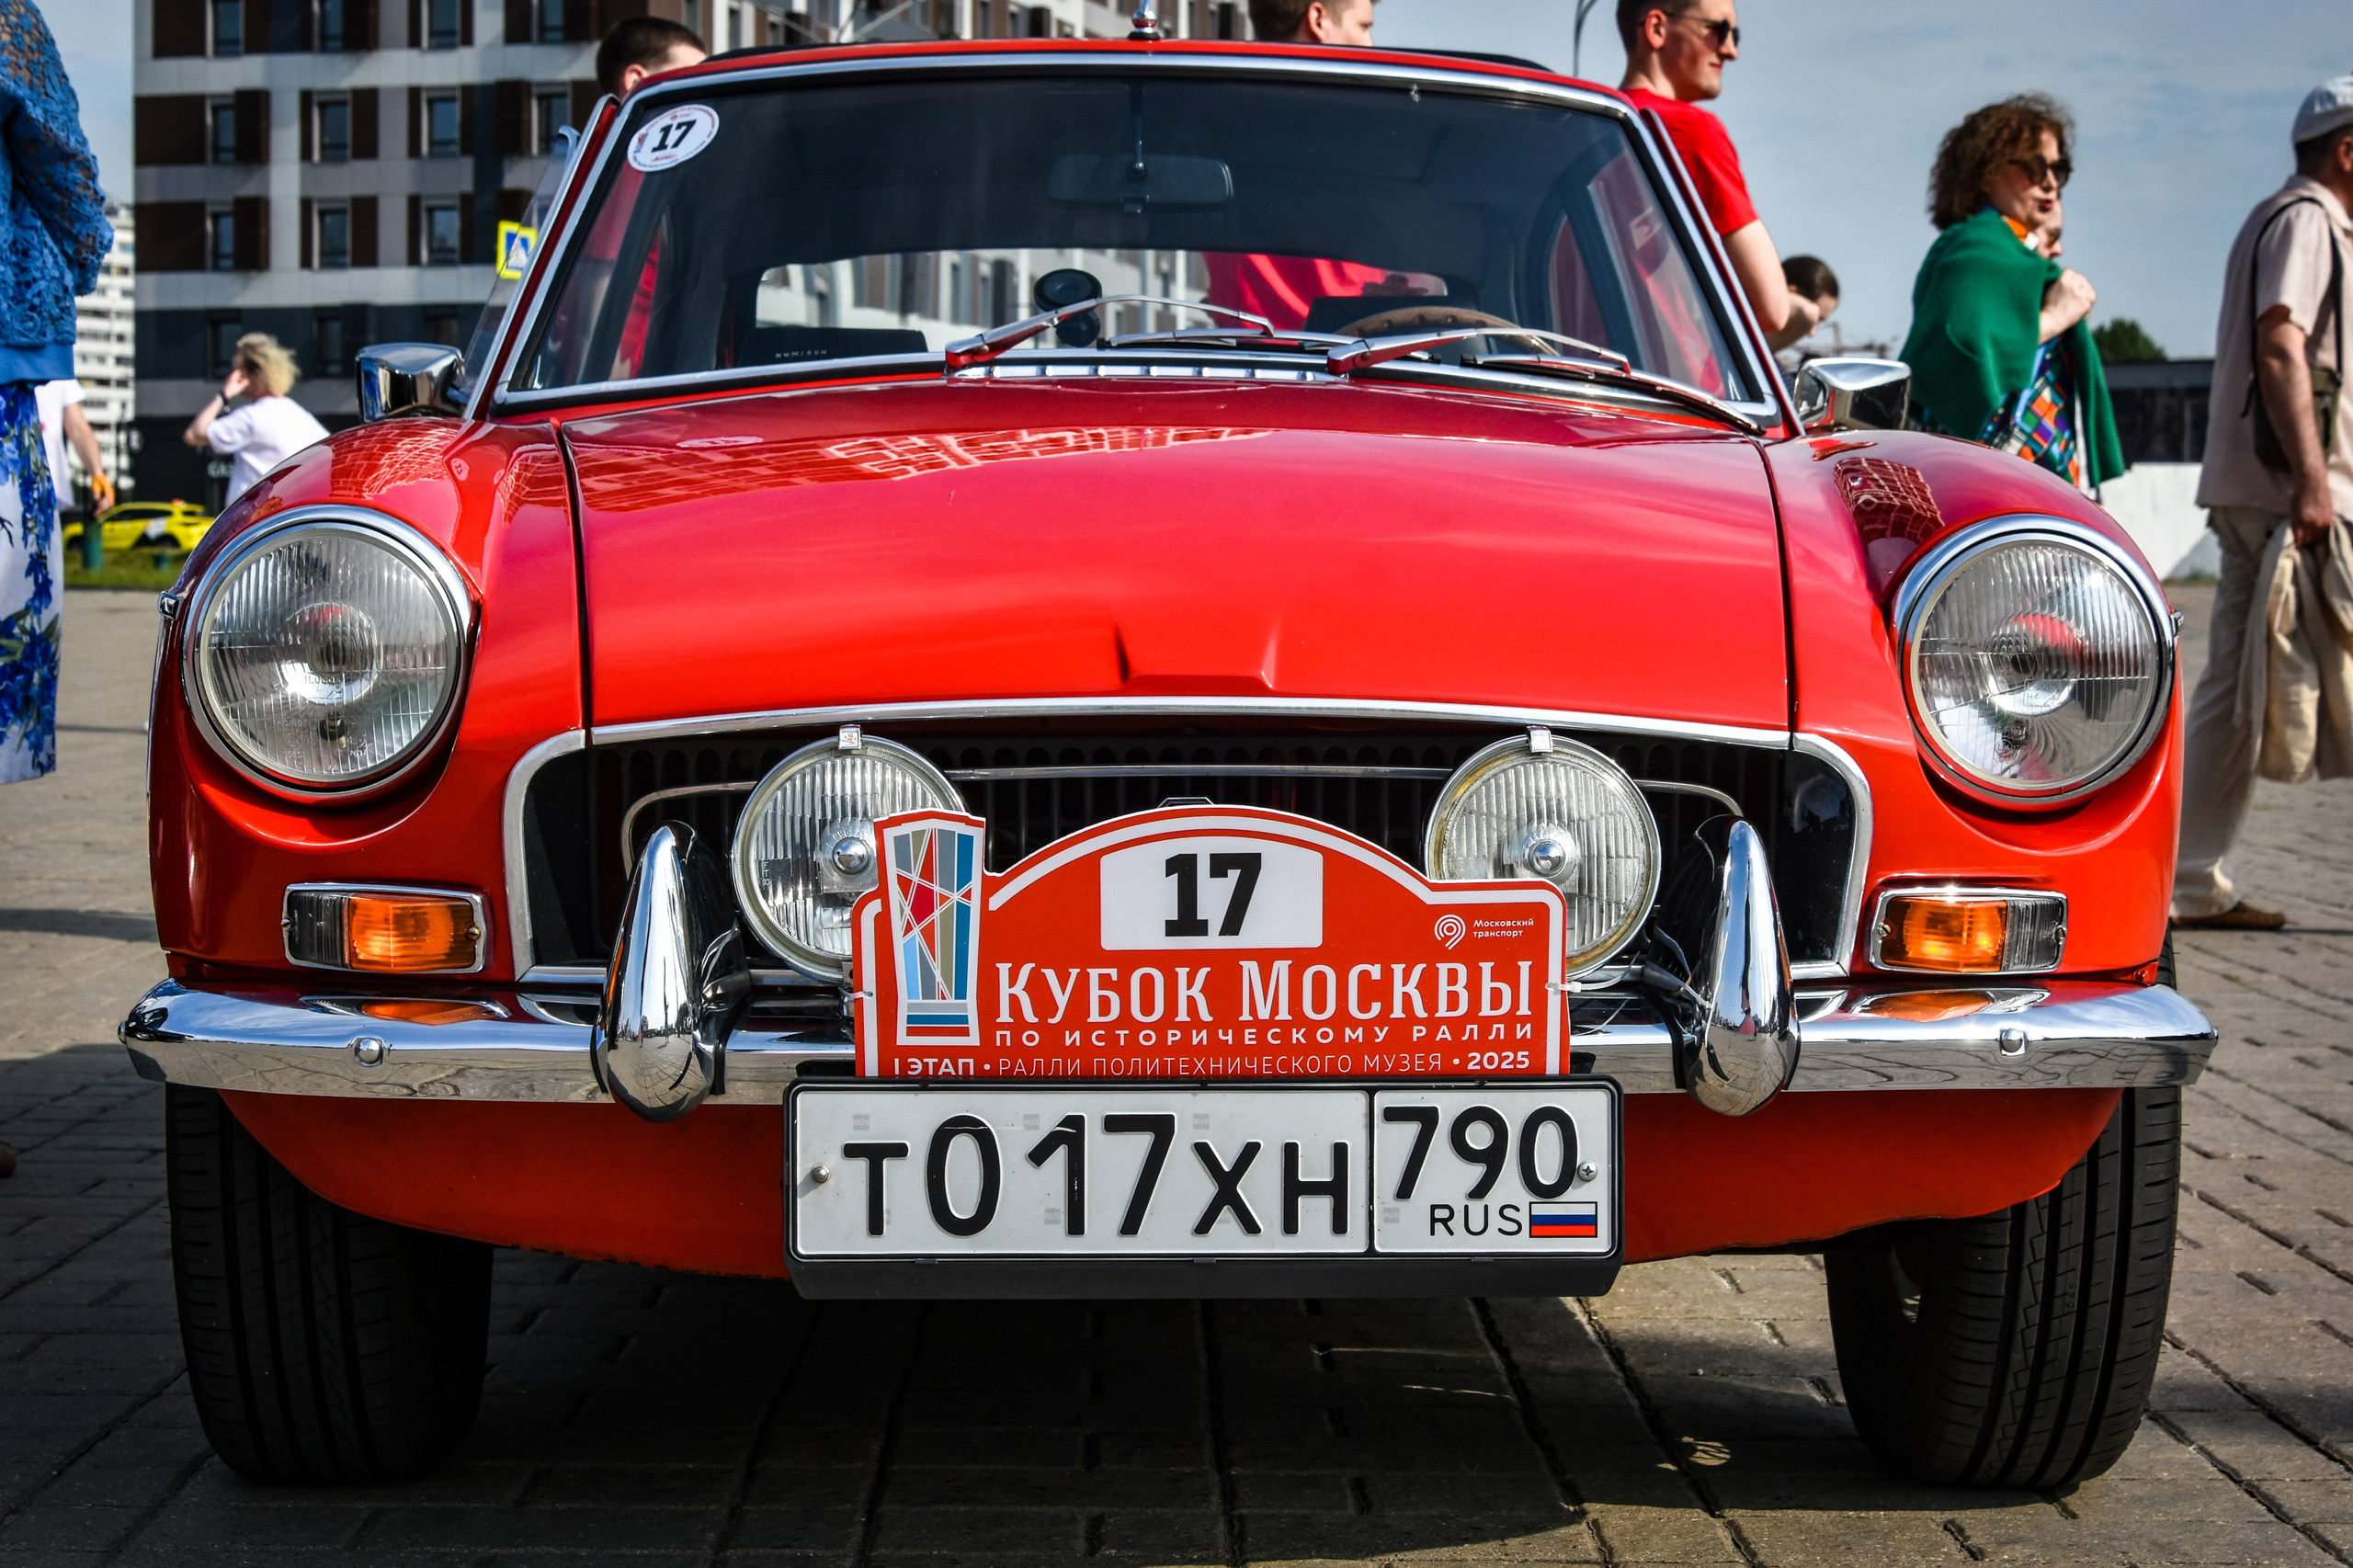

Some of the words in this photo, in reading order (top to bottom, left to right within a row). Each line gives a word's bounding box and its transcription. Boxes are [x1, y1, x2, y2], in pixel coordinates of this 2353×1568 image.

[651, 119, 698, 153] 17
[1165, 852, 1262, 937] 17
[1473, 918, 1534, 927] Московский
[1473, 930, 1523, 938] транспорт
[995, 962, 1213, 1024] КУБОК
[1238, 960, 1532, 1021] МОСКВЫ
[995, 1030, 1040, 1047] ПО
[1064, 1027, 1389, 1047] ИСТОРИЧЕСКОМУ
[1413, 1023, 1532, 1042] РАЛЛИ
[907, 1058, 974, 1075] ЭТАП
[999, 1058, 1081, 1075] РАЛЛИ
[1093, 1055, 1352, 1075] ПОЛИТЕХНИЧЕСКОГО
[1365, 1053, 1441, 1072] МУЗЕЯ
[1467, 1051, 1530, 1071] 2025
[1383, 1106, 1578, 1199] 790
[1430, 1204, 1522, 1236] RUS
